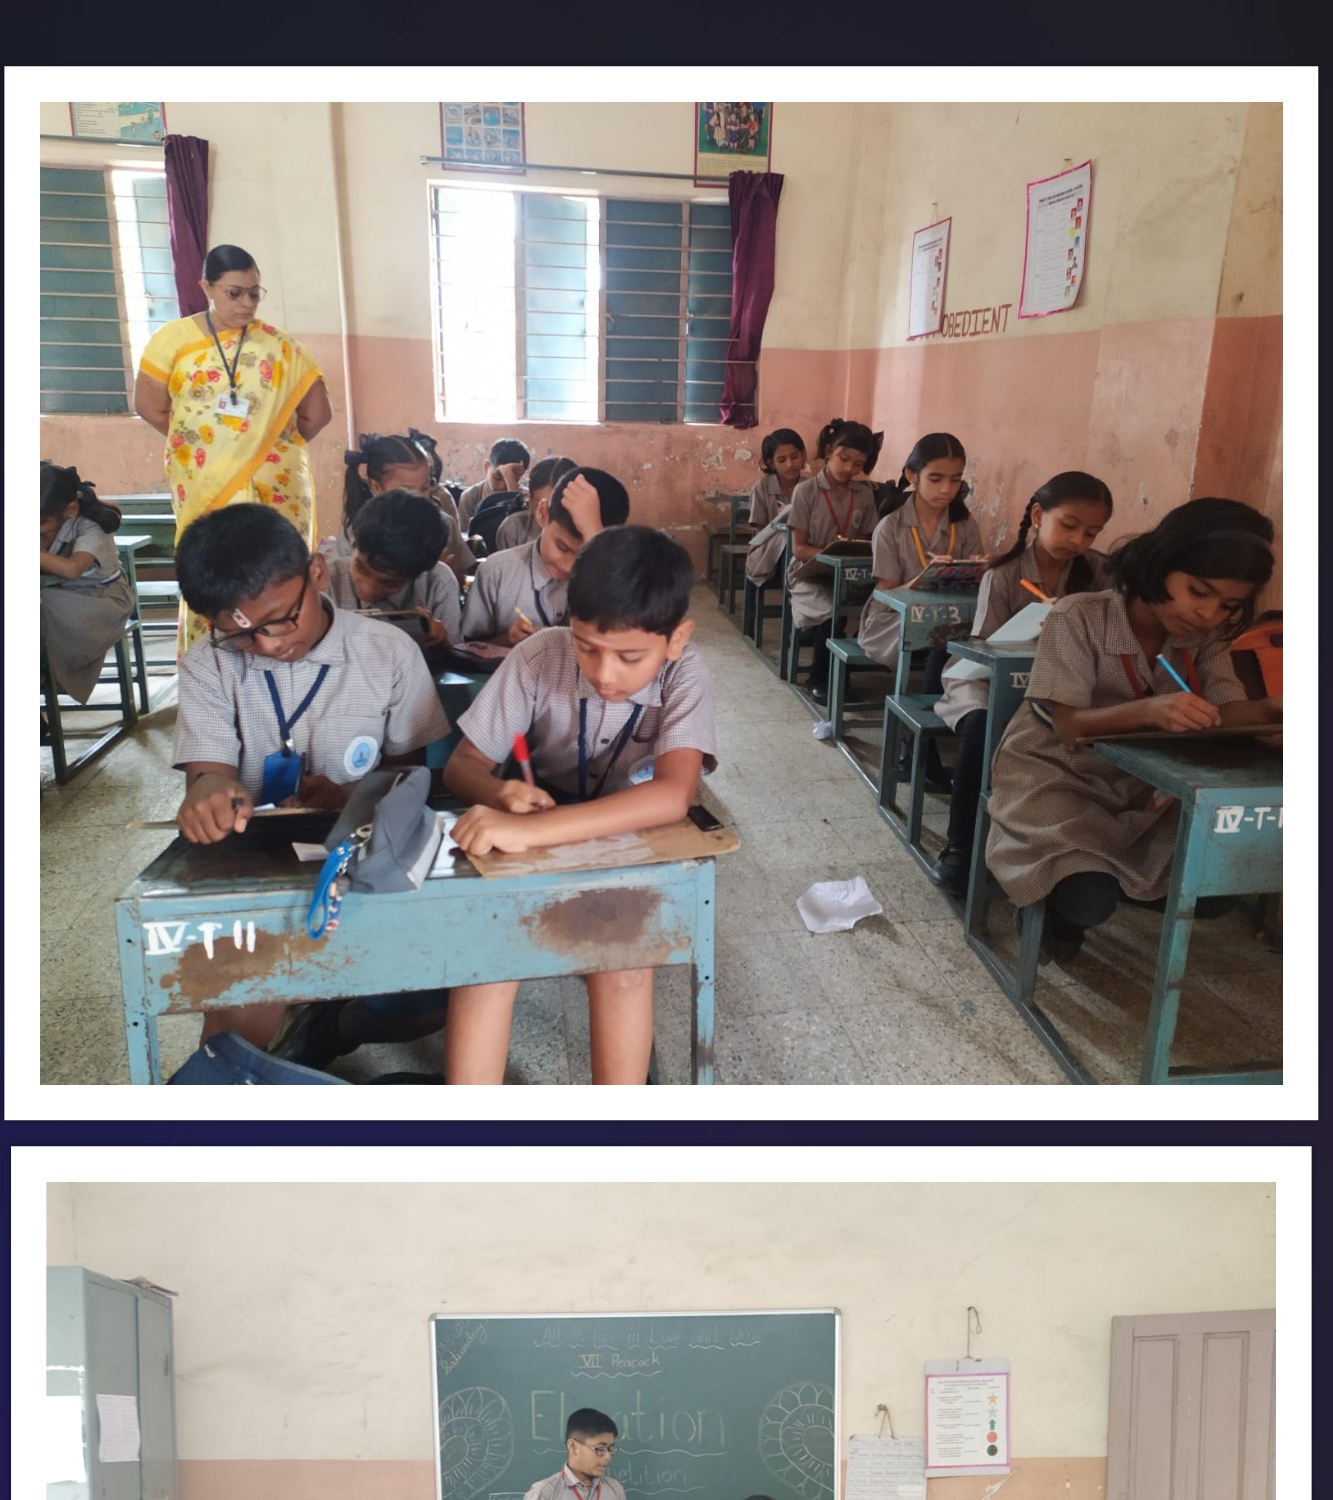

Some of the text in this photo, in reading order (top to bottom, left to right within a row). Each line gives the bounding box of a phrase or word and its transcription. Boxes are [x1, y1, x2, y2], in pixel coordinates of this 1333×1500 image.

[941, 304, 1012, 339] OBEDIENT
[578, 1351, 661, 1369] VII Peacock
